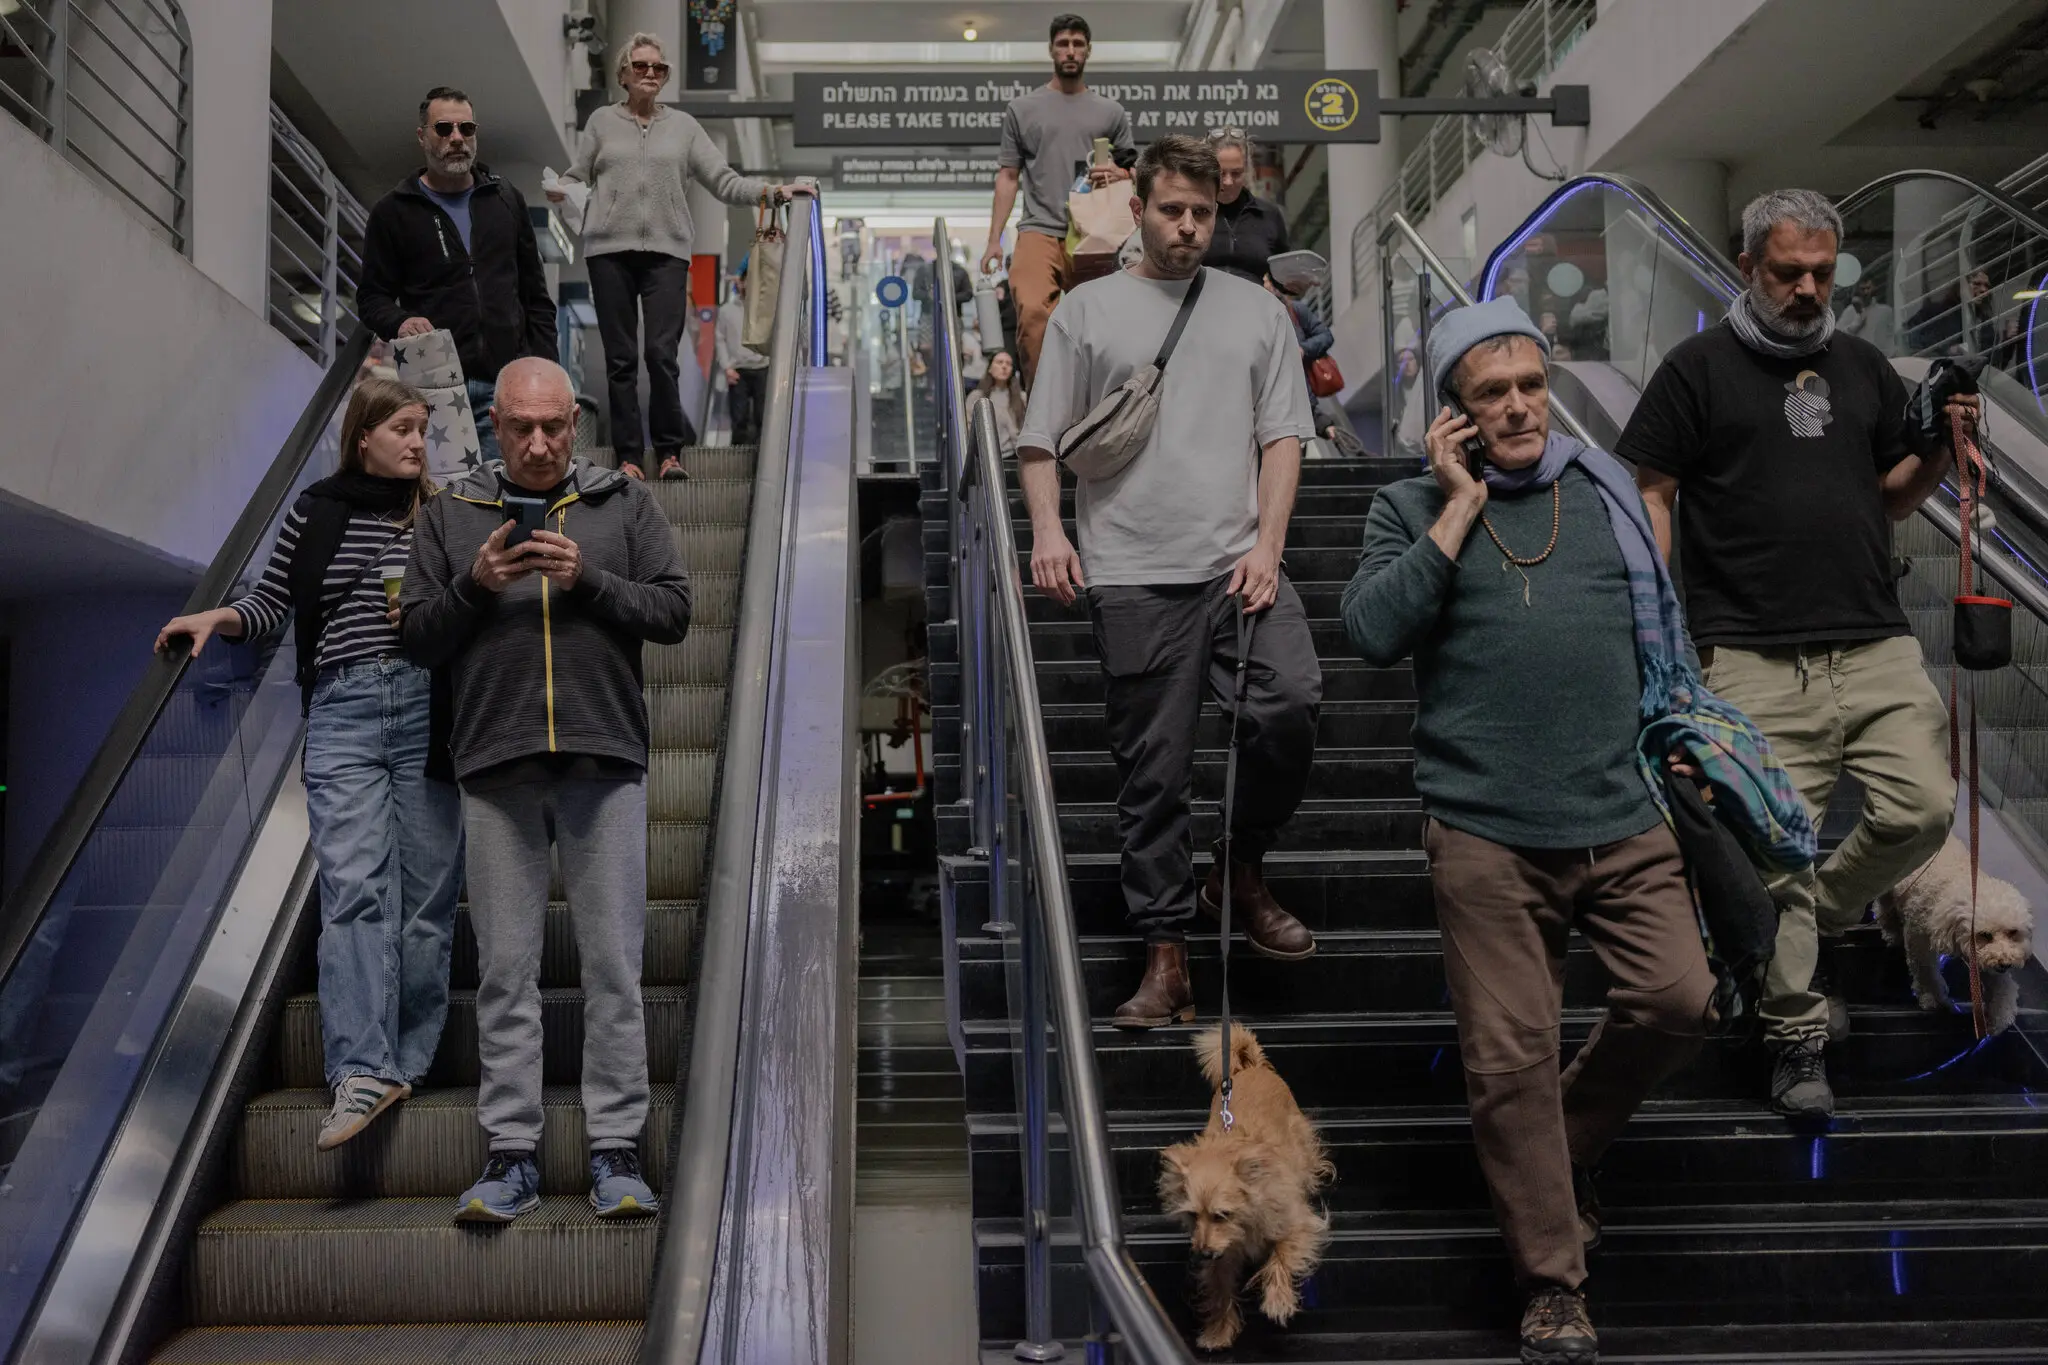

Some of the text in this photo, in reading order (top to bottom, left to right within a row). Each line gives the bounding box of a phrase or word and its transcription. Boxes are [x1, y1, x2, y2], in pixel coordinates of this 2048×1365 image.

[822, 80, 898, 102] התשלום
[903, 84, 969, 102] בעמדת
[1163, 84, 1191, 101] את
[1197, 79, 1249, 105] לקחת
[1256, 84, 1278, 100] נא
[823, 112, 891, 129] PLEASE
[895, 112, 943, 128] TAKE
[1137, 111, 1160, 127] AT
[1165, 110, 1199, 127] PAY
[1203, 110, 1279, 127] STATION
